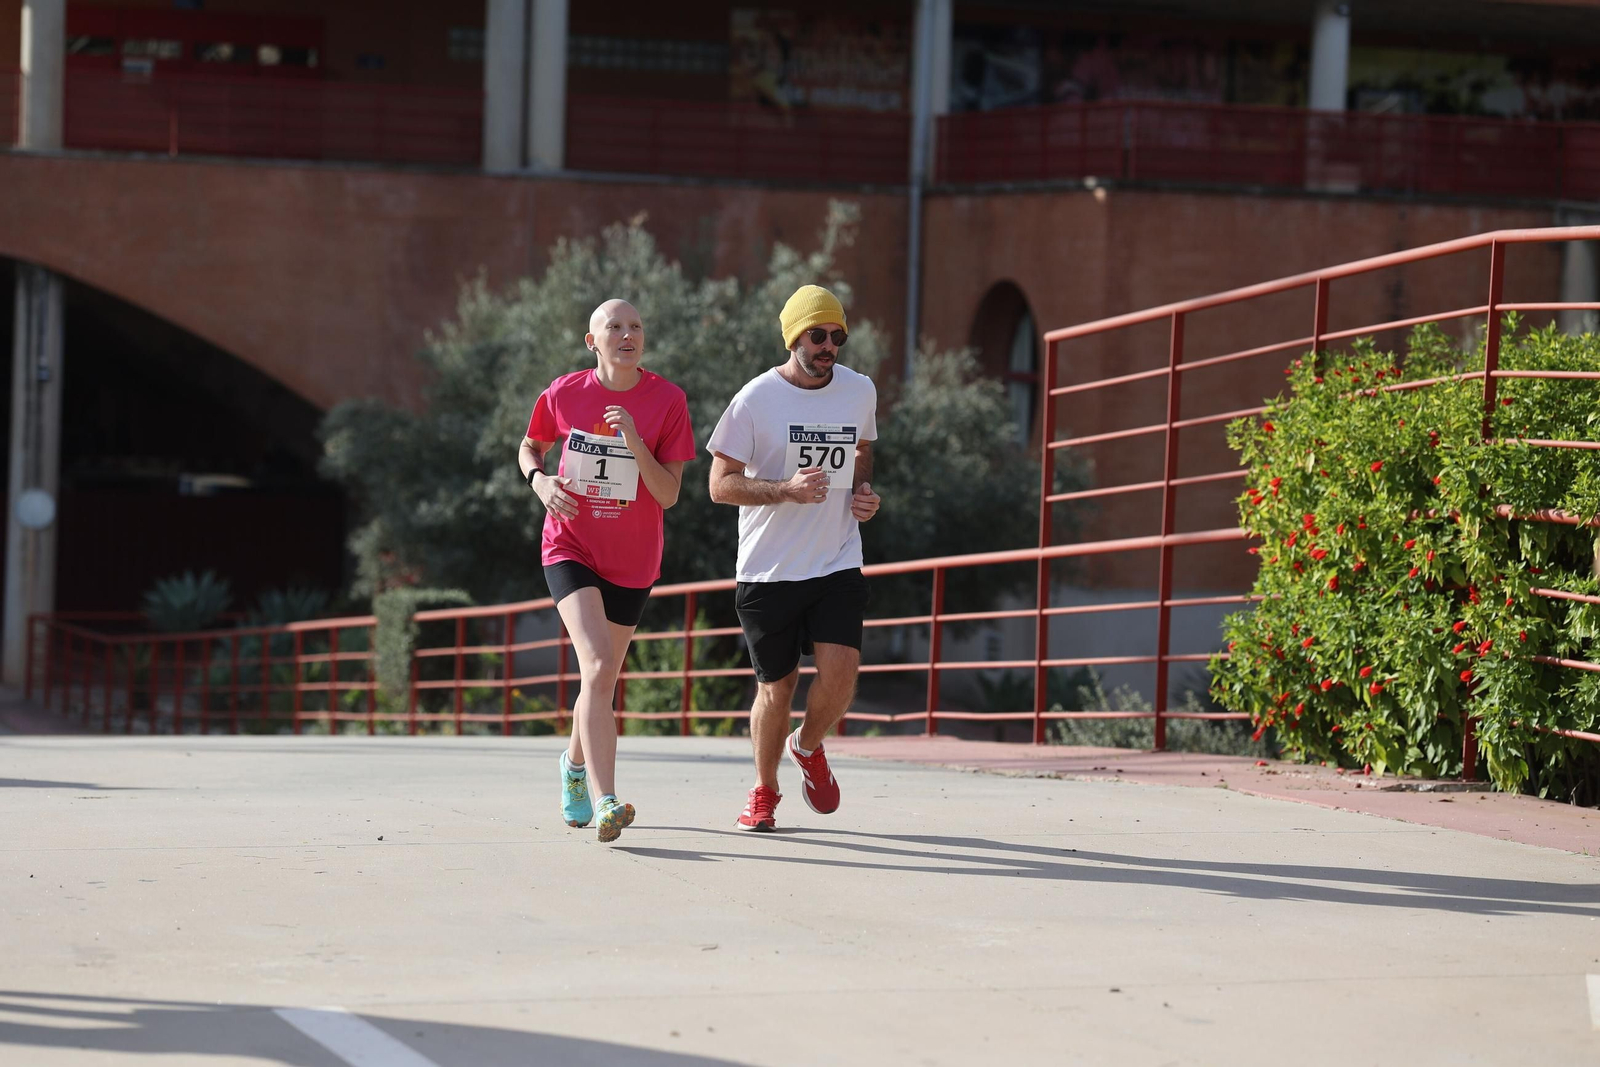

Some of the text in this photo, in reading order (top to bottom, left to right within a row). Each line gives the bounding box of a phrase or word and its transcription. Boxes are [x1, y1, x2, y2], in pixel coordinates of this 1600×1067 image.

[791, 432, 822, 442] UMA
[571, 441, 602, 454] UMA
[798, 446, 846, 470] 570
[595, 459, 609, 480] 1
